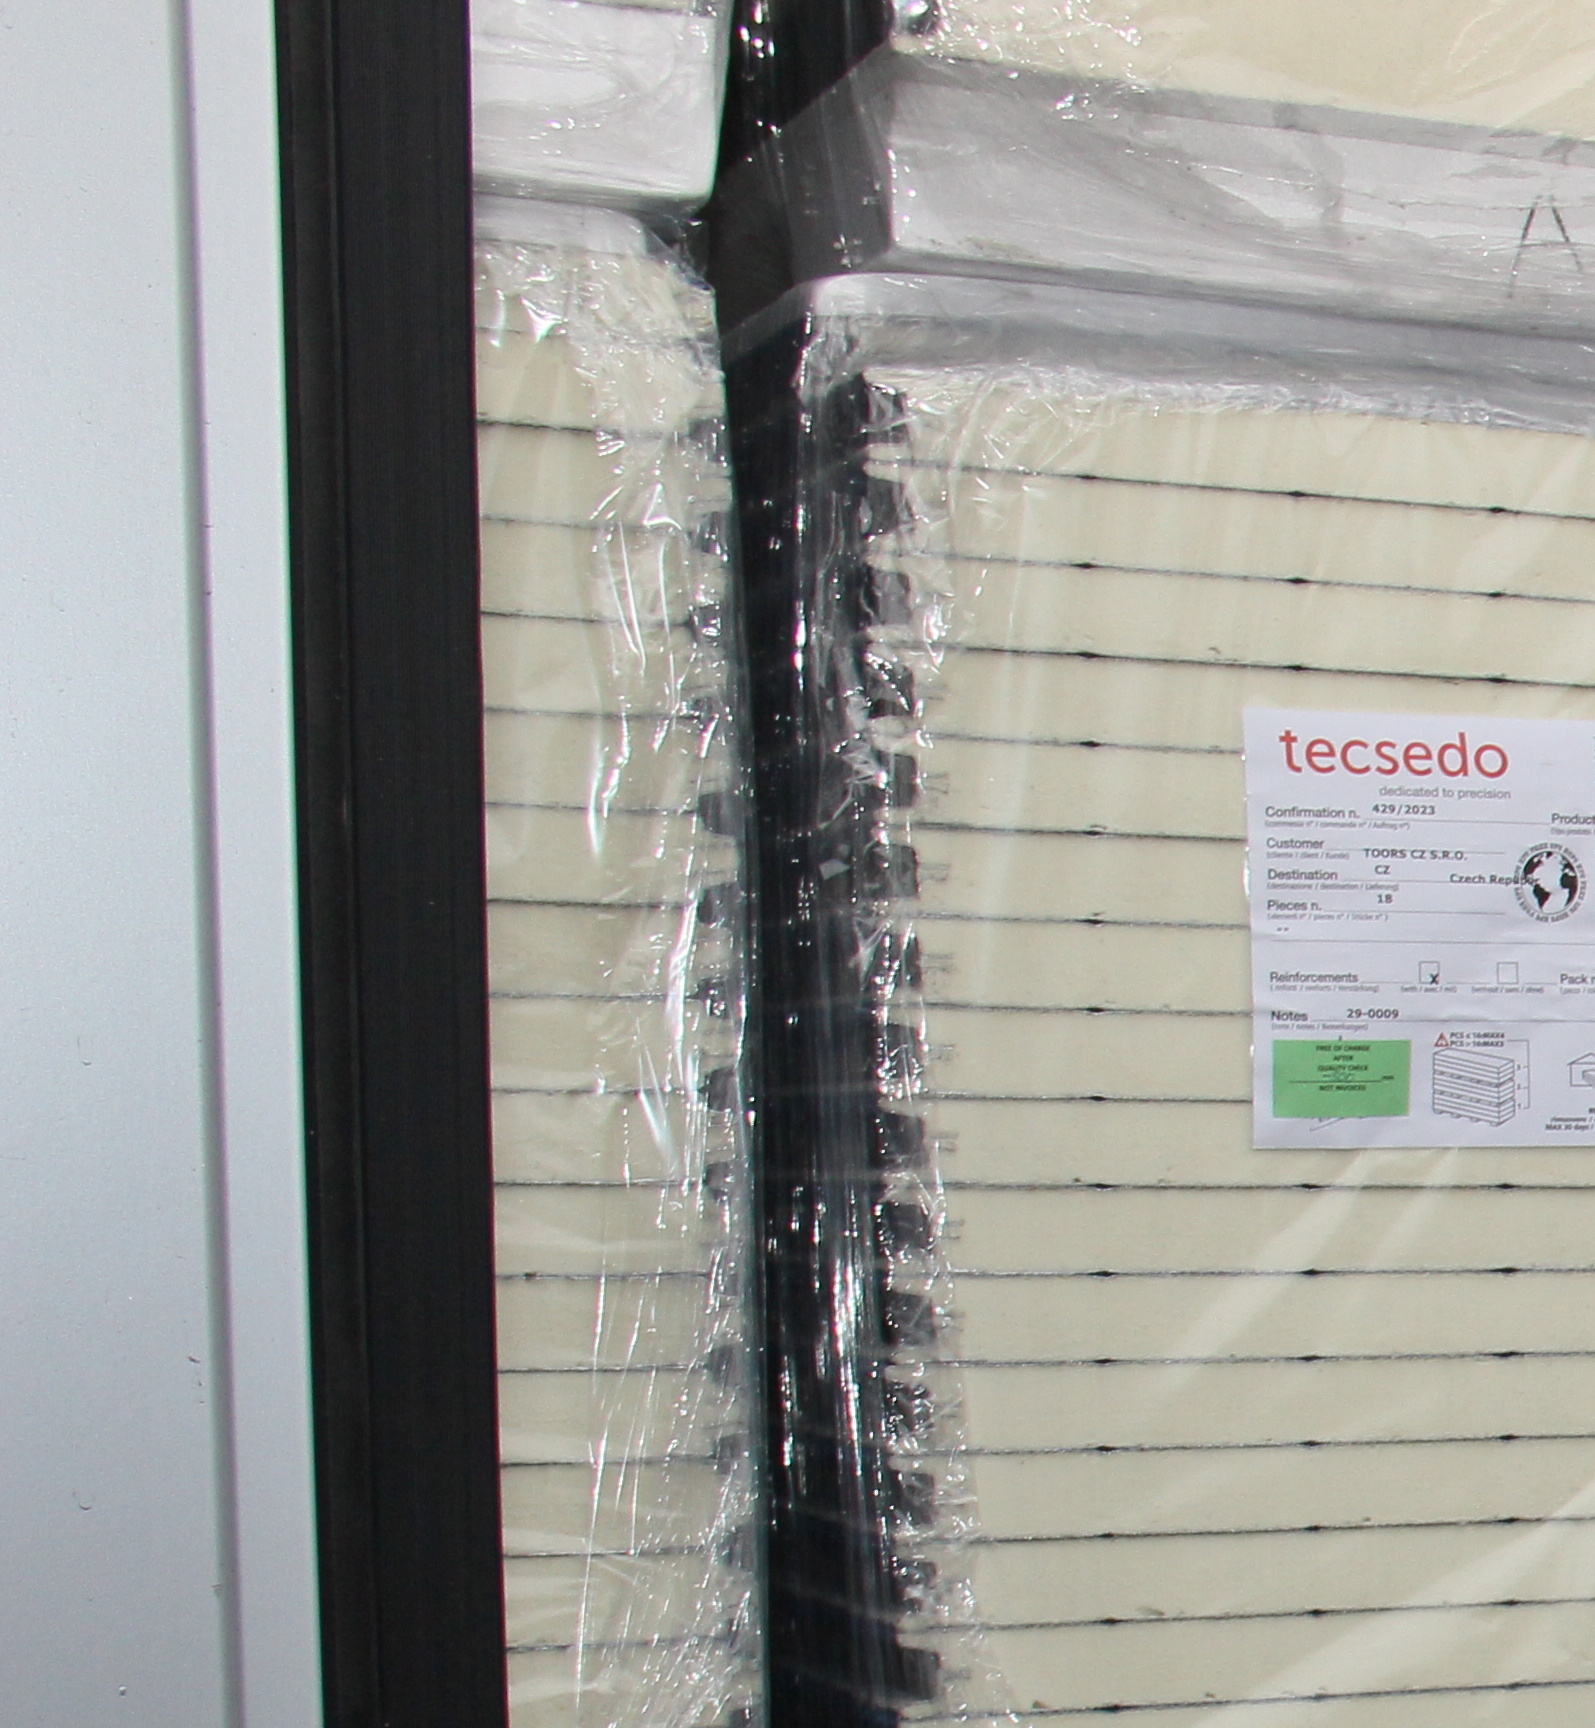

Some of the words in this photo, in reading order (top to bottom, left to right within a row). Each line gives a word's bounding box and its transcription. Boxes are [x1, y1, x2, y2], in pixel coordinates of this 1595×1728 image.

[1279, 729, 1509, 779] tecsedo
[1379, 786, 1439, 798] dedicated
[1442, 788, 1455, 798] to
[1458, 788, 1511, 800] precision
[1265, 806, 1345, 819] Confirmation
[1348, 809, 1360, 818] n.
[1372, 804, 1436, 816] 429/2023
[1266, 837, 1324, 849] Customer
[1363, 848, 1406, 860] TOORS
[1410, 849, 1427, 860] CZ
[1430, 850, 1468, 861] S.R.O.
[1267, 868, 1337, 881] Destination
[1374, 865, 1391, 874] CZ
[1450, 873, 1486, 884] Czech
[1267, 900, 1308, 911] Pieces
[1310, 902, 1322, 911] n.
[1270, 971, 1359, 983] Reinforcements
[1560, 973, 1587, 985] Pack
[1271, 1011, 1308, 1021] Notes
[1347, 1009, 1399, 1019] 29-0009
